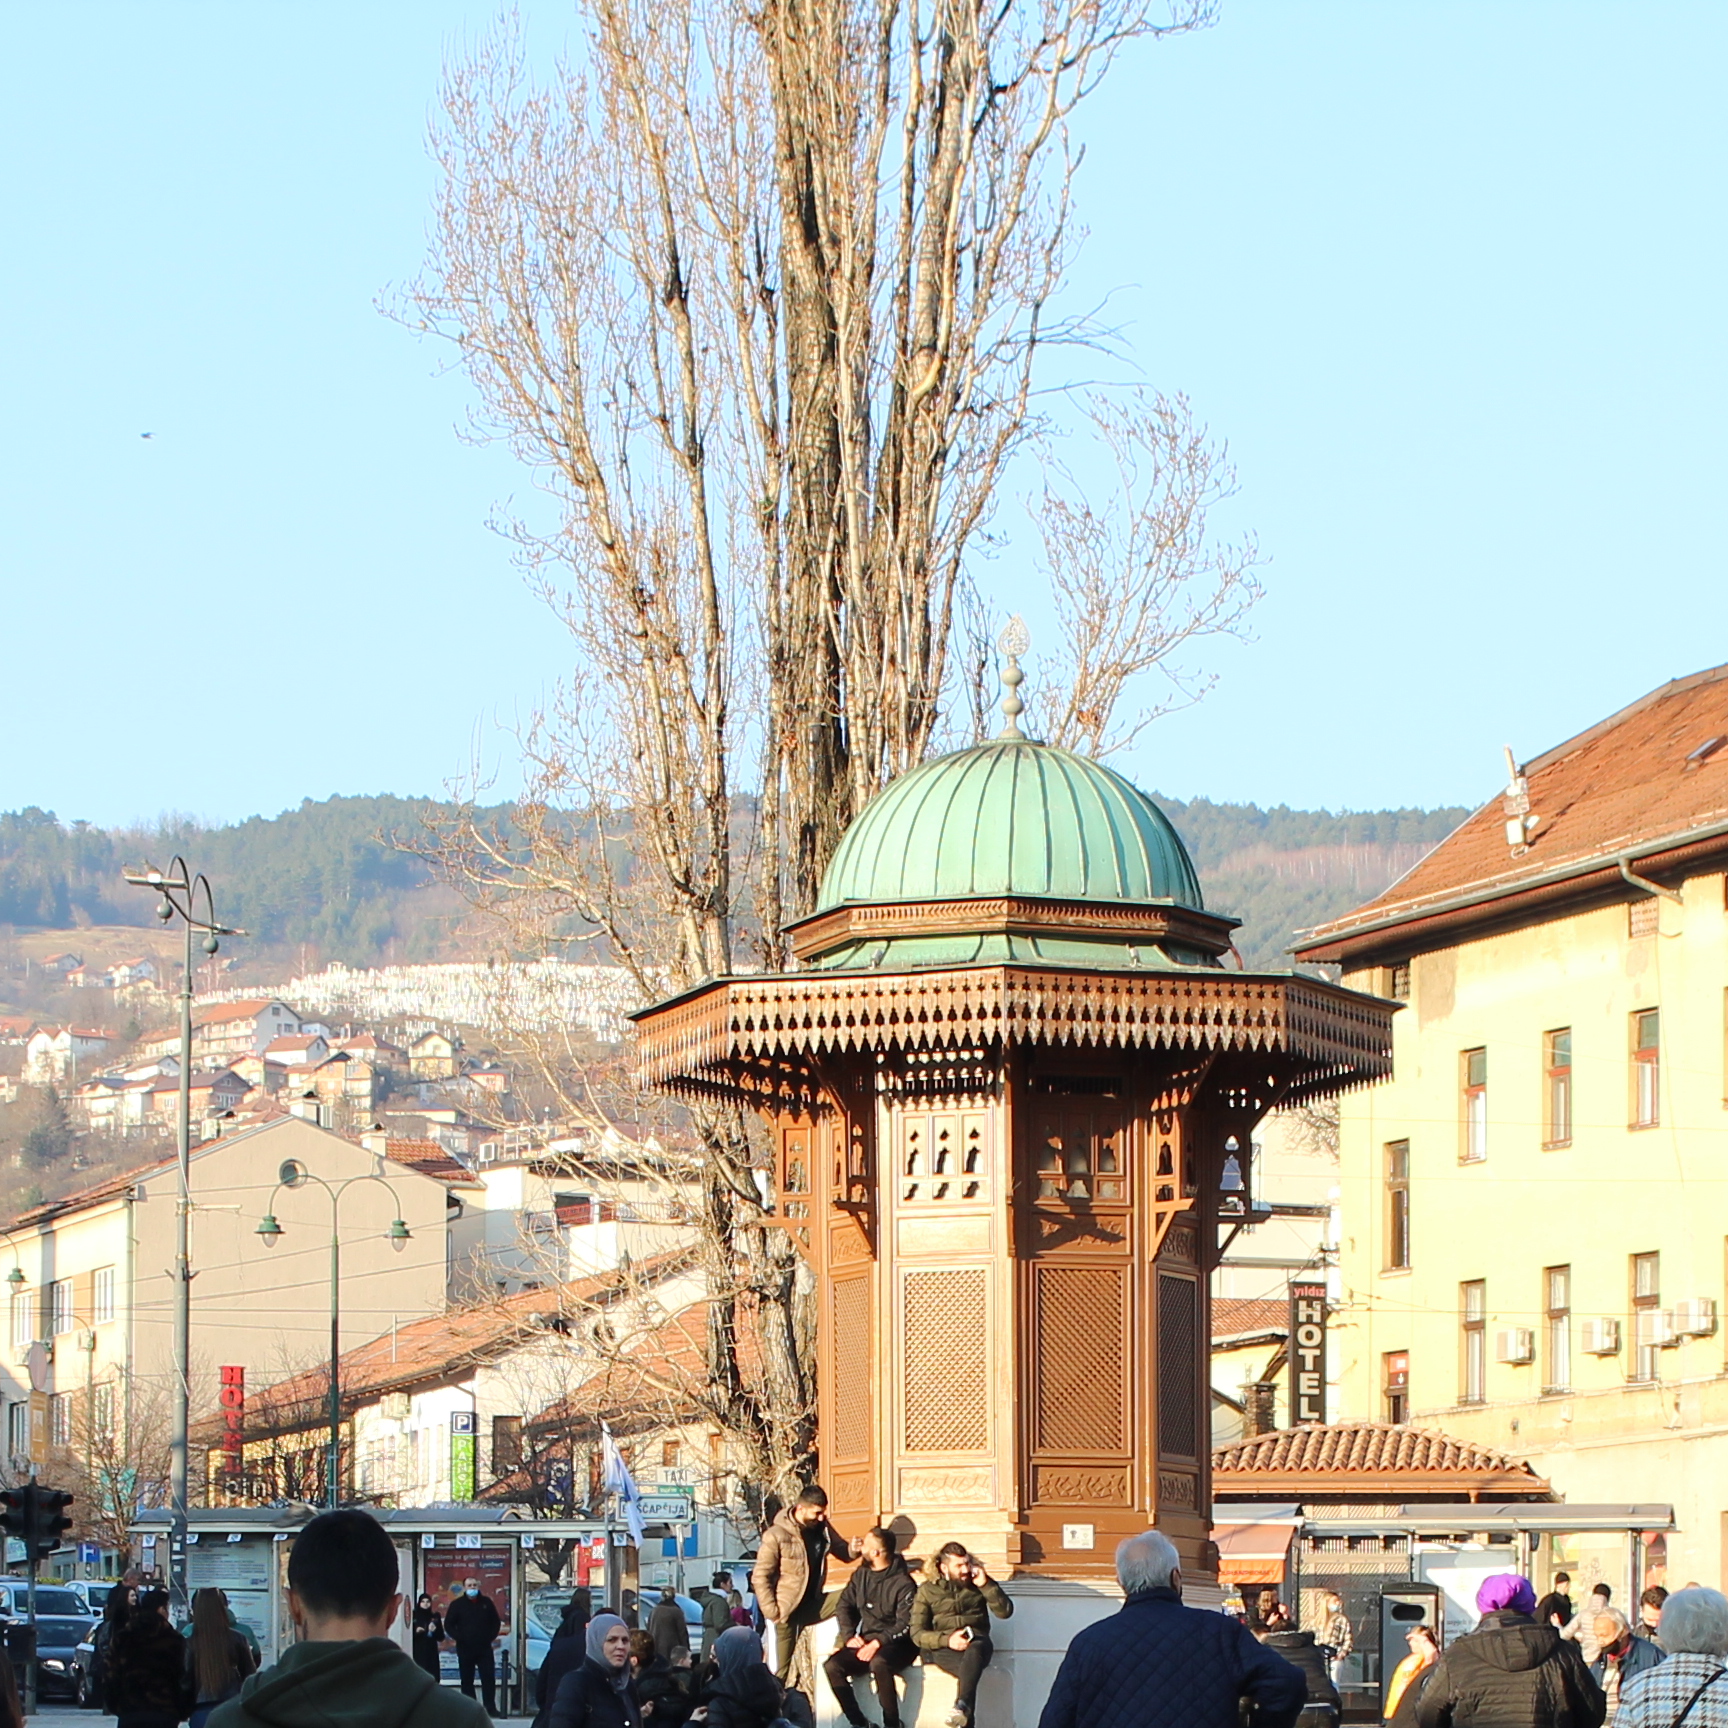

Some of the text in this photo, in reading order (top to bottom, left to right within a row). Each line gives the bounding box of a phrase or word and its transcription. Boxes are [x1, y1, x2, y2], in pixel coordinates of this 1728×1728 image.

[1297, 1300, 1322, 1420] HOTEL
[220, 1365, 244, 1474] HOTEL
[457, 1416, 468, 1429] P
[663, 1470, 688, 1482] TAXI
